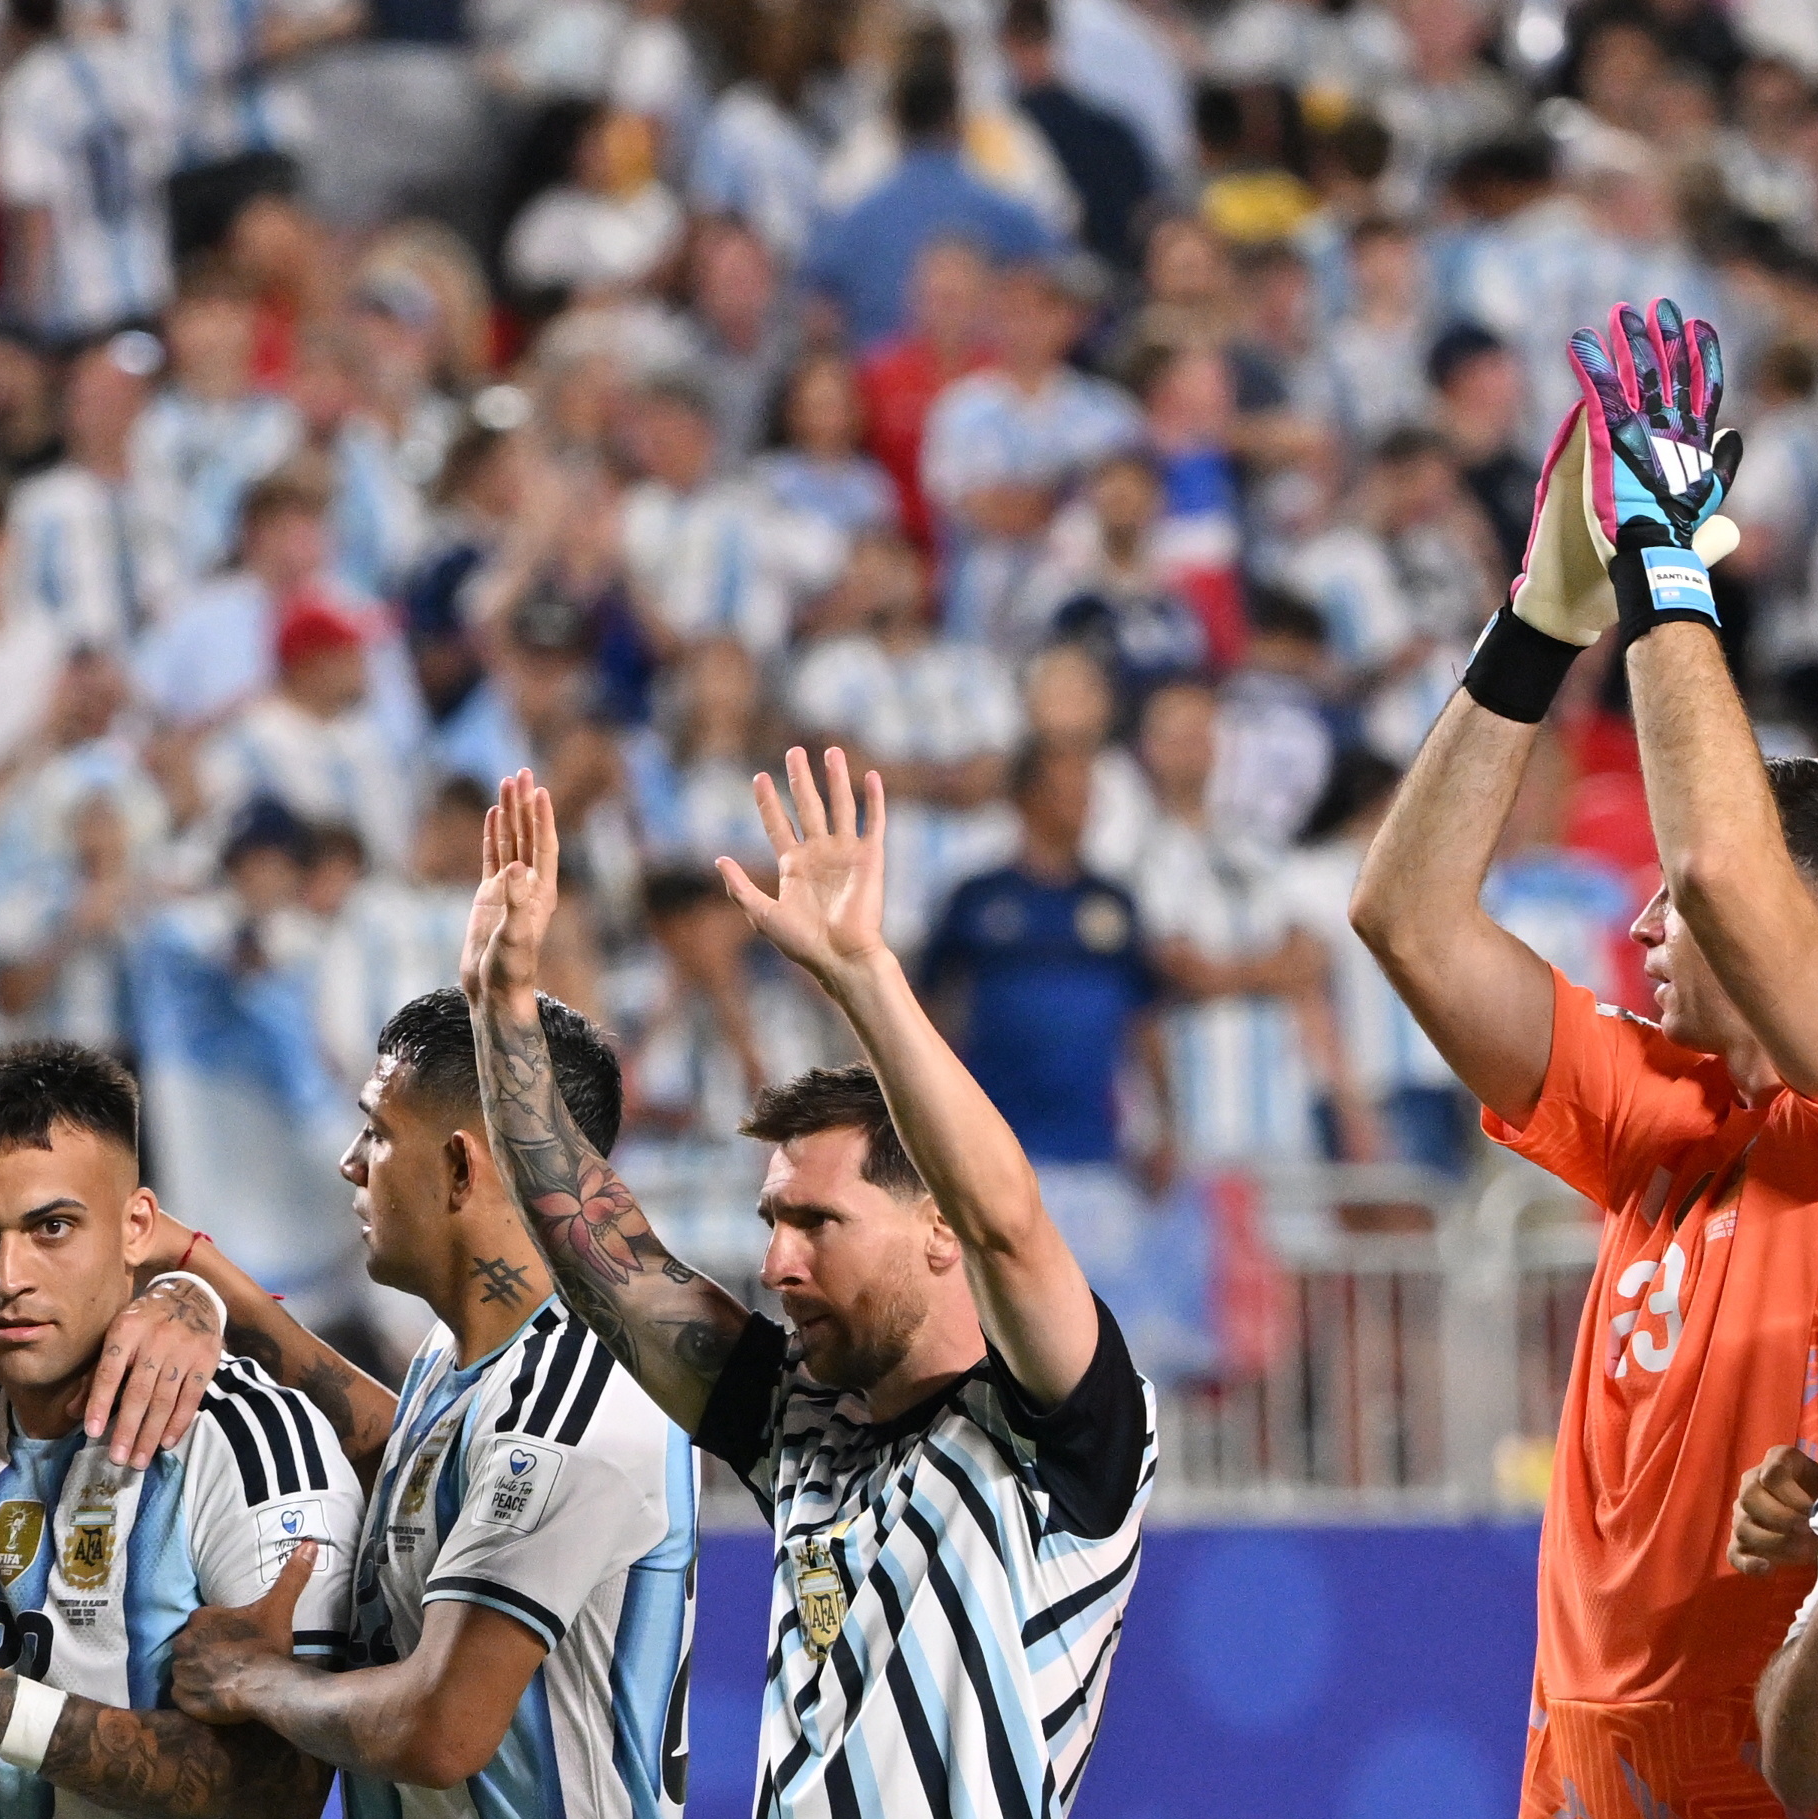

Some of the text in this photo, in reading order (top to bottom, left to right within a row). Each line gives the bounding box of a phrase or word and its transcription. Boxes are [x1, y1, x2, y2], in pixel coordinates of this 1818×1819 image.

[494, 1475, 533, 1495] Unite For
[491, 1492, 527, 1512] PEACE
[494, 1510, 512, 1520] FIFA
[74, 1528, 103, 1567] AFA
[812, 1593, 837, 1634] AFA
